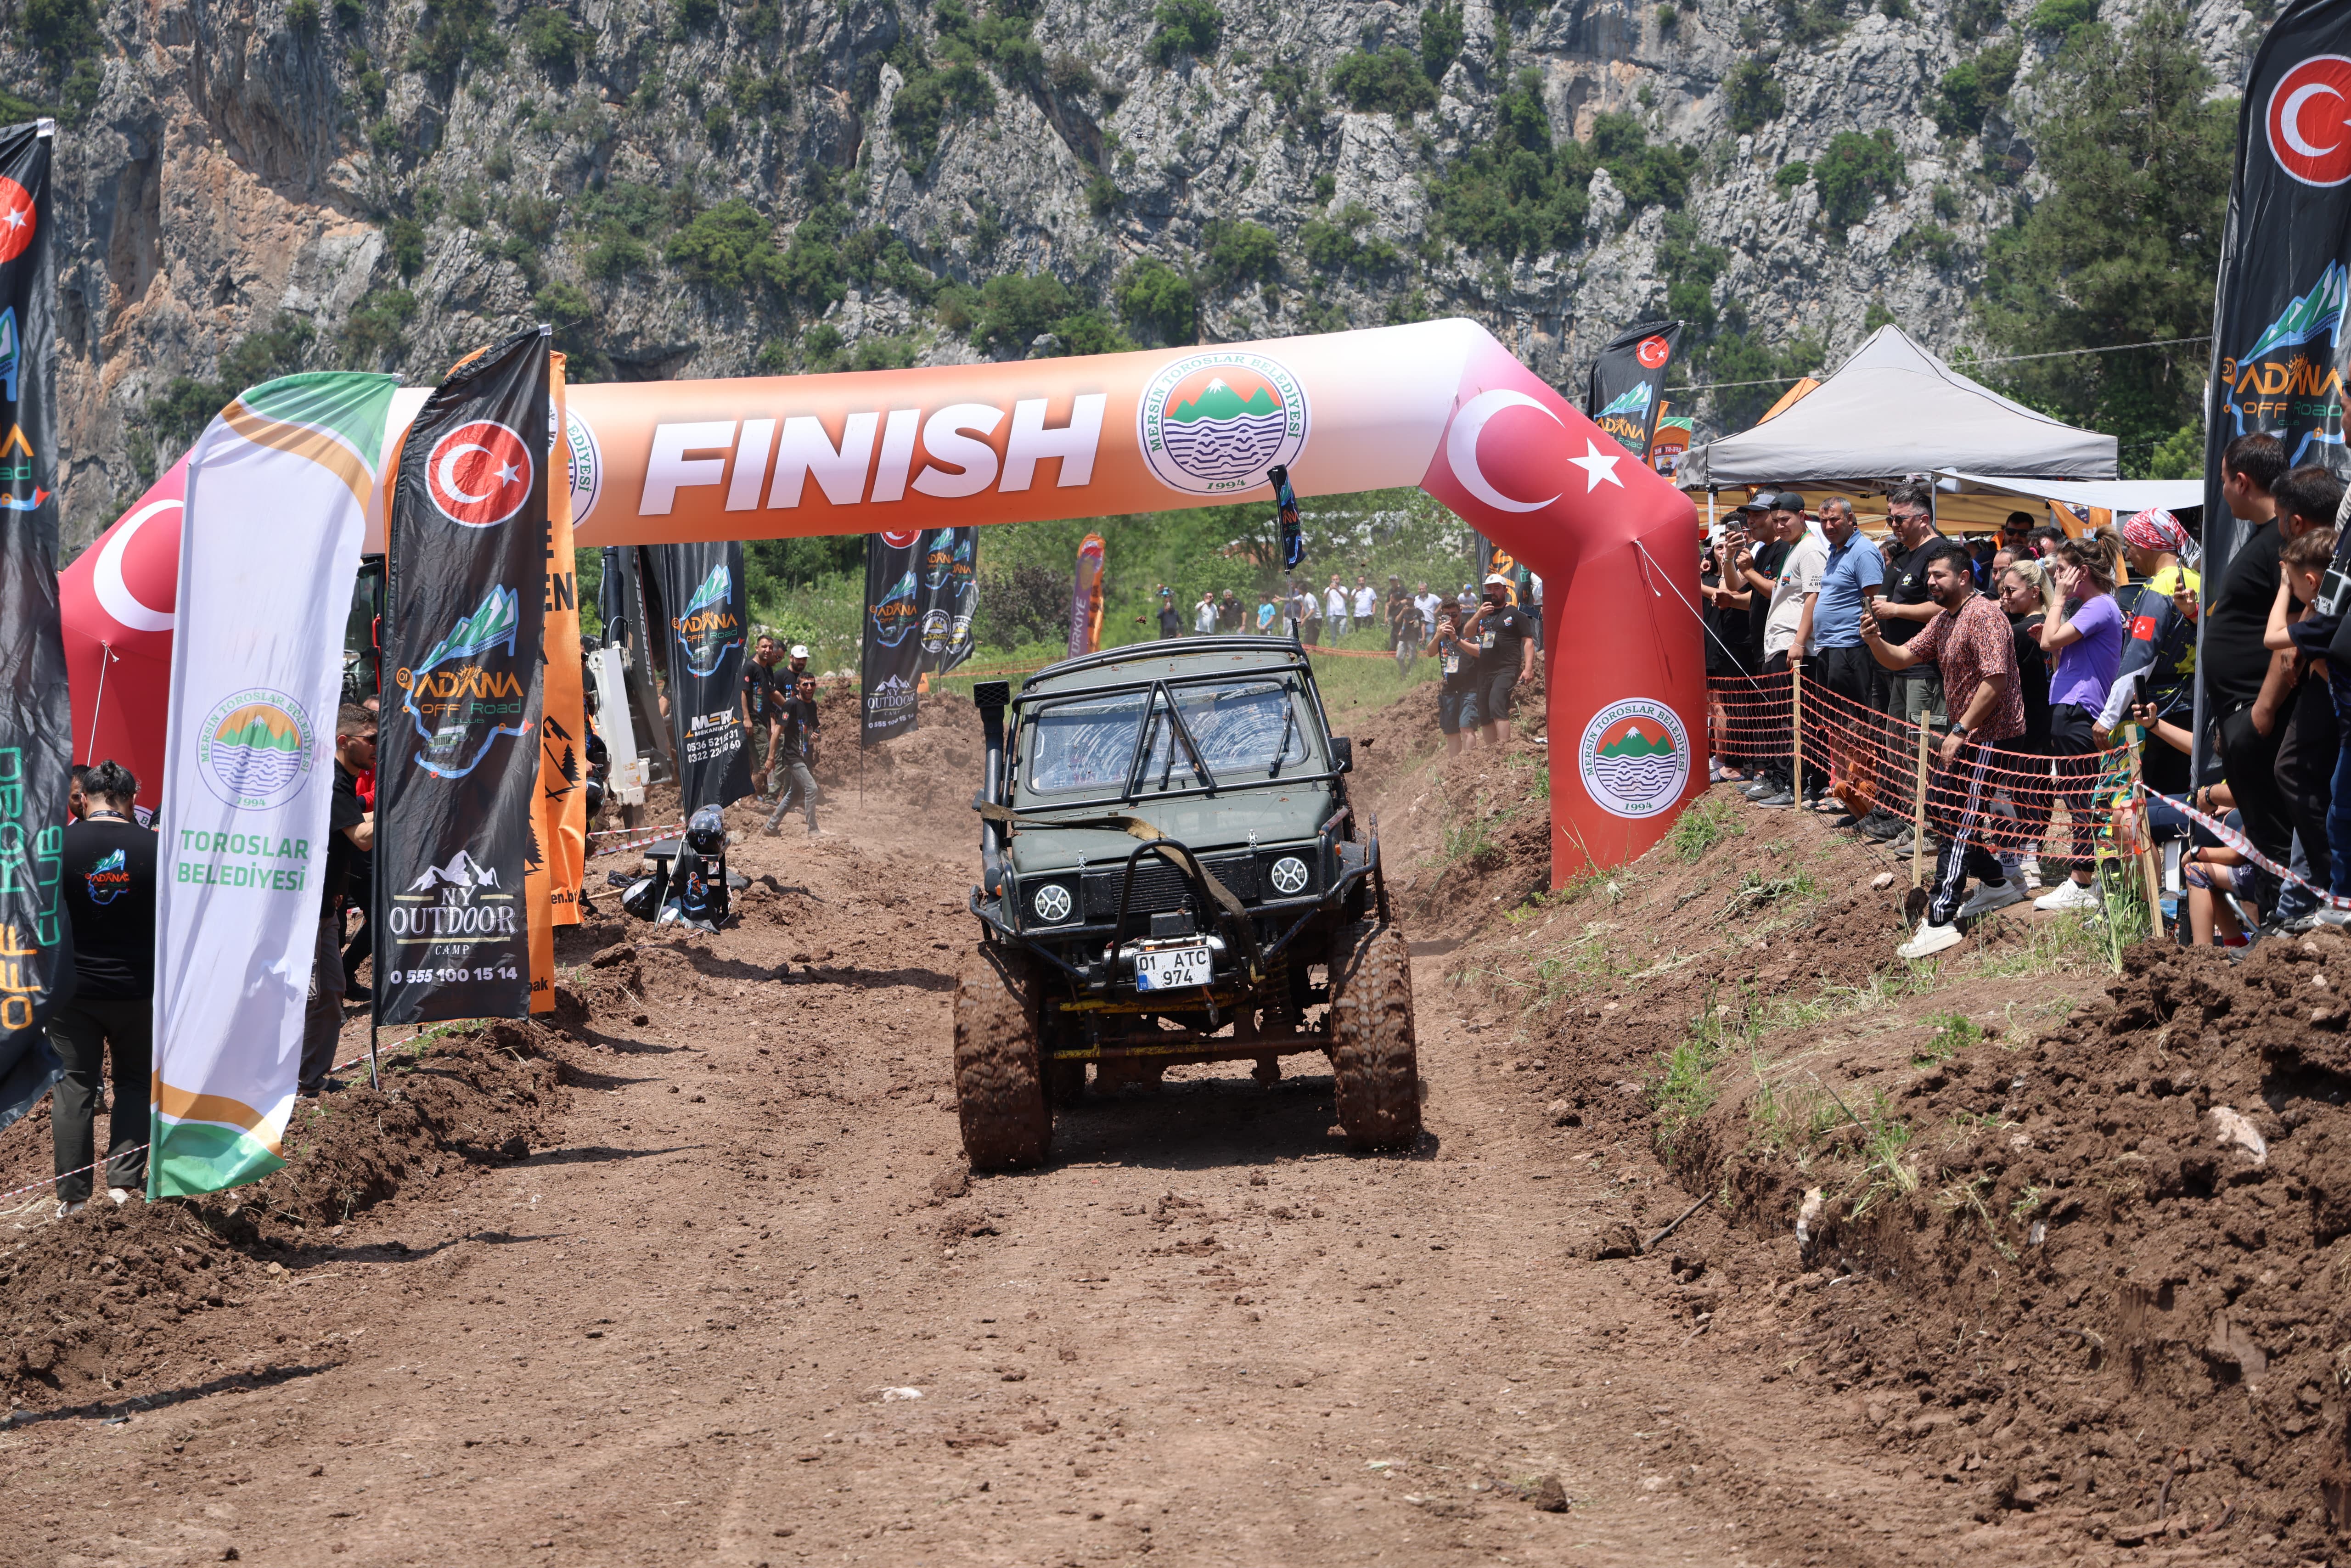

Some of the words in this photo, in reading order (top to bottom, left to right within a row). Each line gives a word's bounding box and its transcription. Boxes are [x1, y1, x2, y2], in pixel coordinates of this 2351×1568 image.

[2236, 362, 2343, 397] ADANA
[1148, 388, 1165, 453] MERSİN
[1162, 355, 1245, 385] TOROSLAR
[1250, 358, 1301, 438] BELEDİYESİ
[2243, 402, 2288, 419] OFF
[1595, 417, 1646, 441] ADANA
[1618, 437, 1644, 450] Road
[567, 418, 592, 492] EDİYESİ
[638, 393, 1108, 516] FINISH
[1205, 479, 1247, 490] 1994
[877, 605, 917, 616] ADANA
[682, 613, 738, 634] ADANA
[687, 634, 706, 643] OFF
[710, 627, 737, 639] Road
[399, 672, 408, 681] 01
[414, 672, 524, 698] ADANA
[867, 692, 915, 709] OUTDOOR
[887, 687, 900, 696] NY
[421, 703, 461, 717] OFF
[471, 697, 521, 715] Road
[201, 714, 220, 763] MERSİN
[219, 692, 285, 714] TOROSLAR
[286, 702, 313, 773] BELEDİYESİ
[687, 740, 707, 752] 0536
[729, 729, 738, 739] 31
[1585, 731, 1597, 776] MERSİN
[1596, 705, 1655, 730] TOROSLAR
[1657, 711, 1685, 772] BELEDİYESİ
[688, 750, 708, 763] 0322
[730, 739, 741, 749] 60
[236, 797, 266, 807] 1994
[1624, 802, 1653, 811] 1994
[181, 829, 309, 860] TOROSLAR
[37, 826, 63, 946] CLUB
[92, 874, 128, 882] ADANA
[177, 861, 306, 891] BELEDİYESİ
[441, 884, 478, 906] NY
[389, 906, 518, 935] OUTDOOR
[435, 945, 470, 955] CAMP
[1139, 955, 1156, 971] 01
[1174, 950, 1207, 968] ATC
[390, 970, 402, 984] 0
[406, 969, 433, 984] 555
[436, 968, 469, 982] 100
[473, 967, 494, 981] 15
[497, 967, 518, 980] 14
[1163, 969, 1193, 985] 974
